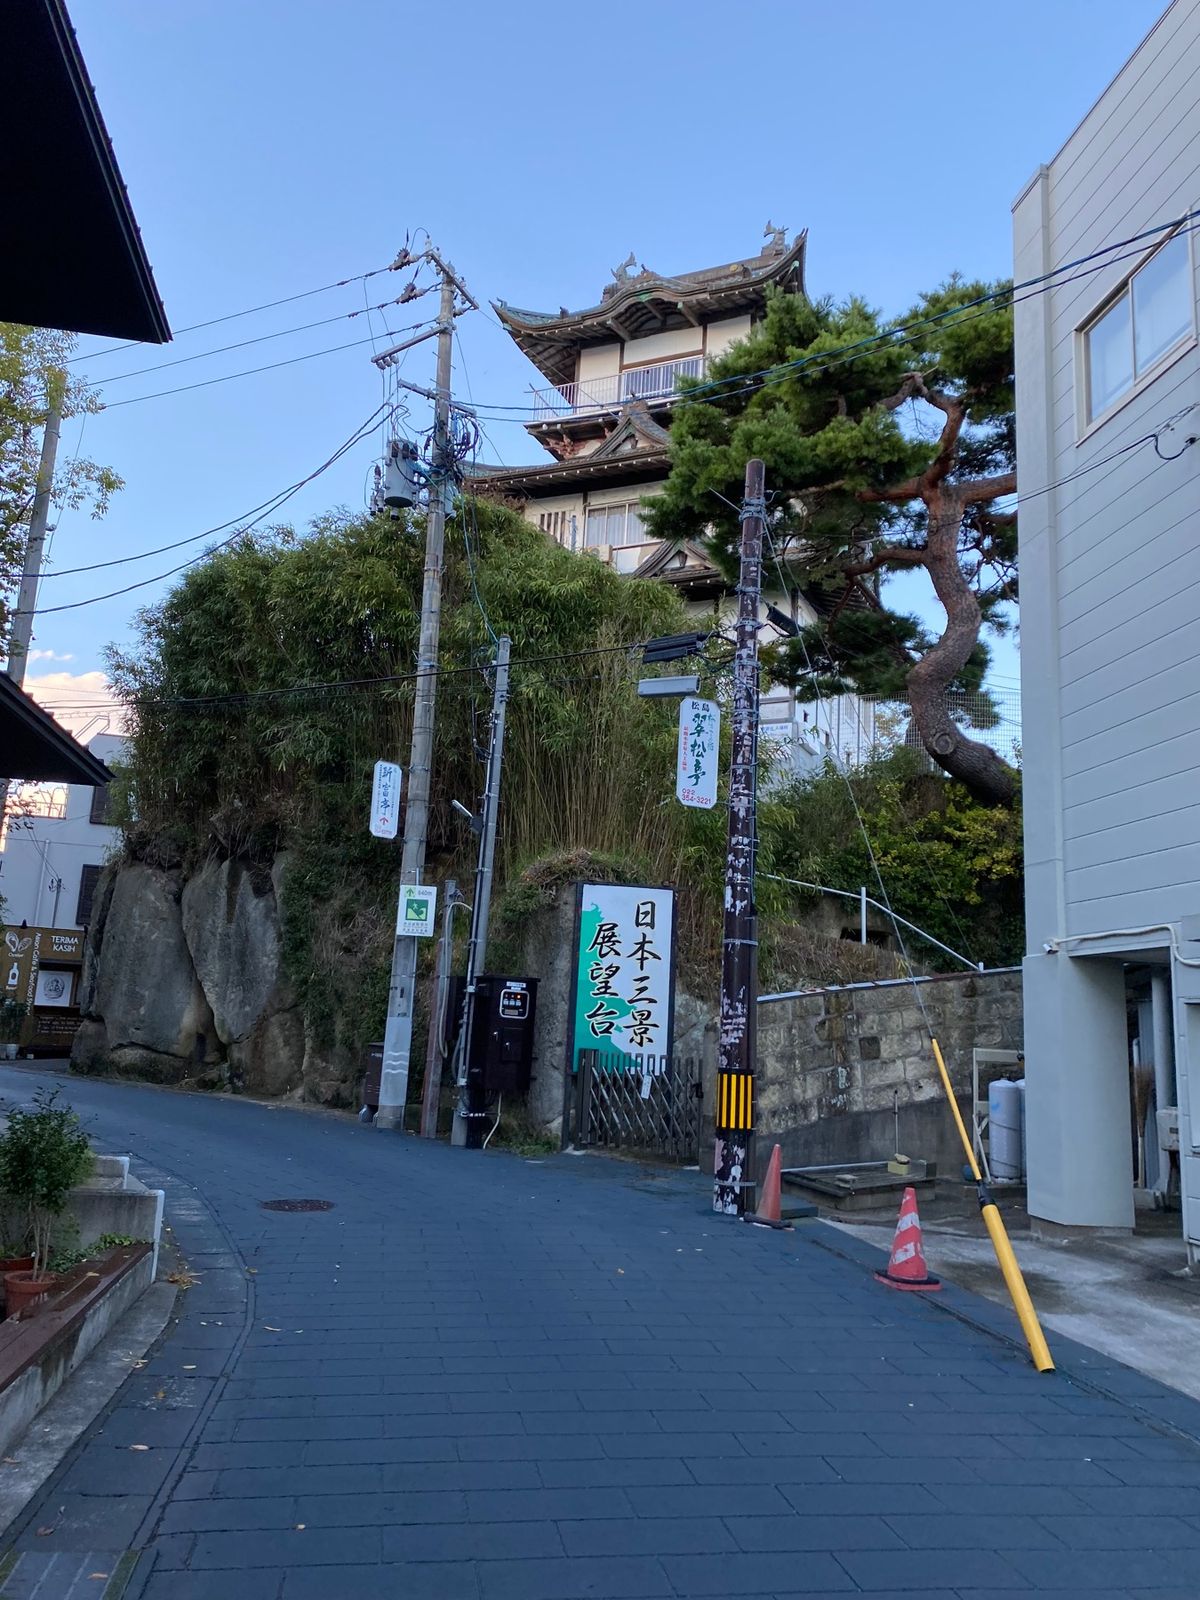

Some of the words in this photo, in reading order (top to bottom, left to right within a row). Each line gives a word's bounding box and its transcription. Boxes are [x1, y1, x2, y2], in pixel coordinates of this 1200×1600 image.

[691, 701, 710, 712] 松島
[688, 713, 707, 786] 翠松亭
[380, 766, 392, 815] 新富亭
[681, 794, 711, 804] 354-3221
[51, 935, 79, 945] TERIMA
[53, 944, 76, 953] KASIH
[585, 922, 622, 1037] 展望台
[623, 901, 662, 1047] 日本三景
